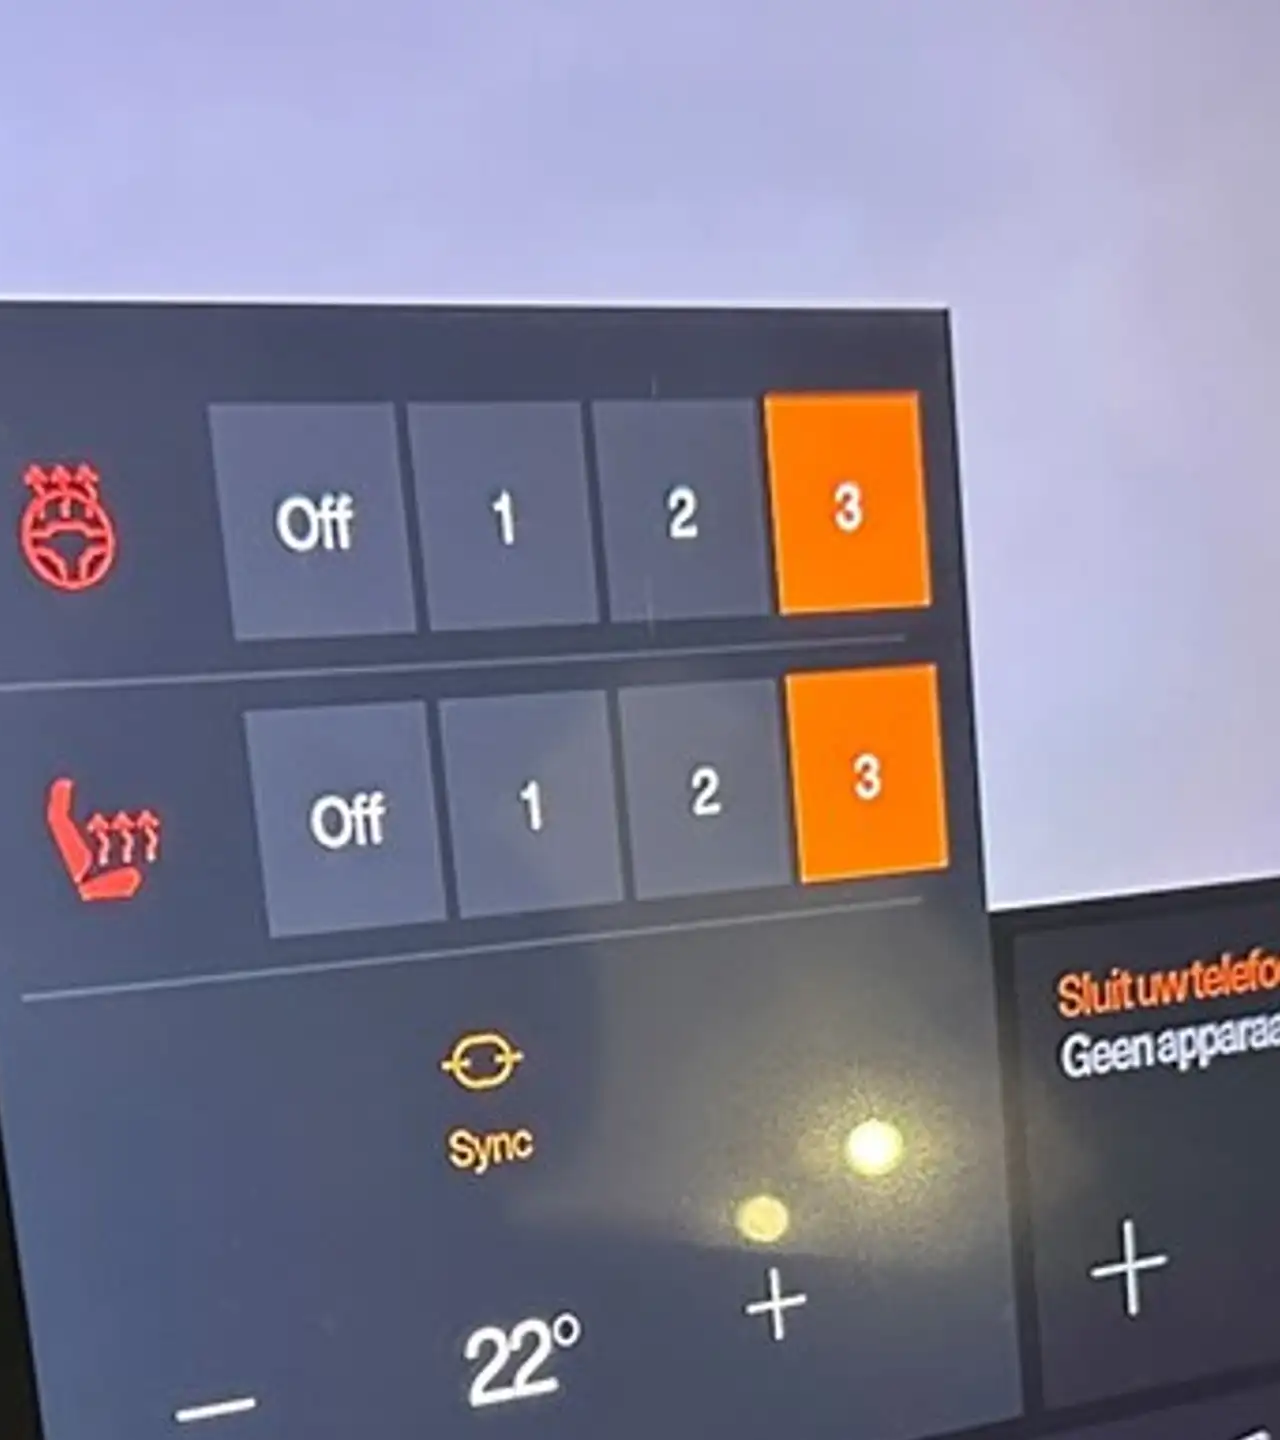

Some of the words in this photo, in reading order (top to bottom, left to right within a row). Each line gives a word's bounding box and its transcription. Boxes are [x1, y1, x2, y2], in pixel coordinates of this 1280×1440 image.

[276, 493, 354, 552] Off
[492, 491, 516, 545] 1
[669, 487, 699, 539] 2
[834, 481, 863, 532] 3
[311, 790, 387, 849] Off
[520, 780, 543, 830] 1
[691, 767, 721, 816] 2
[853, 753, 881, 800] 3
[1057, 970, 1134, 1018] Sluit
[1138, 974, 1186, 1004] uw
[1060, 1031, 1154, 1078] Geen
[448, 1127, 535, 1175] Sync
